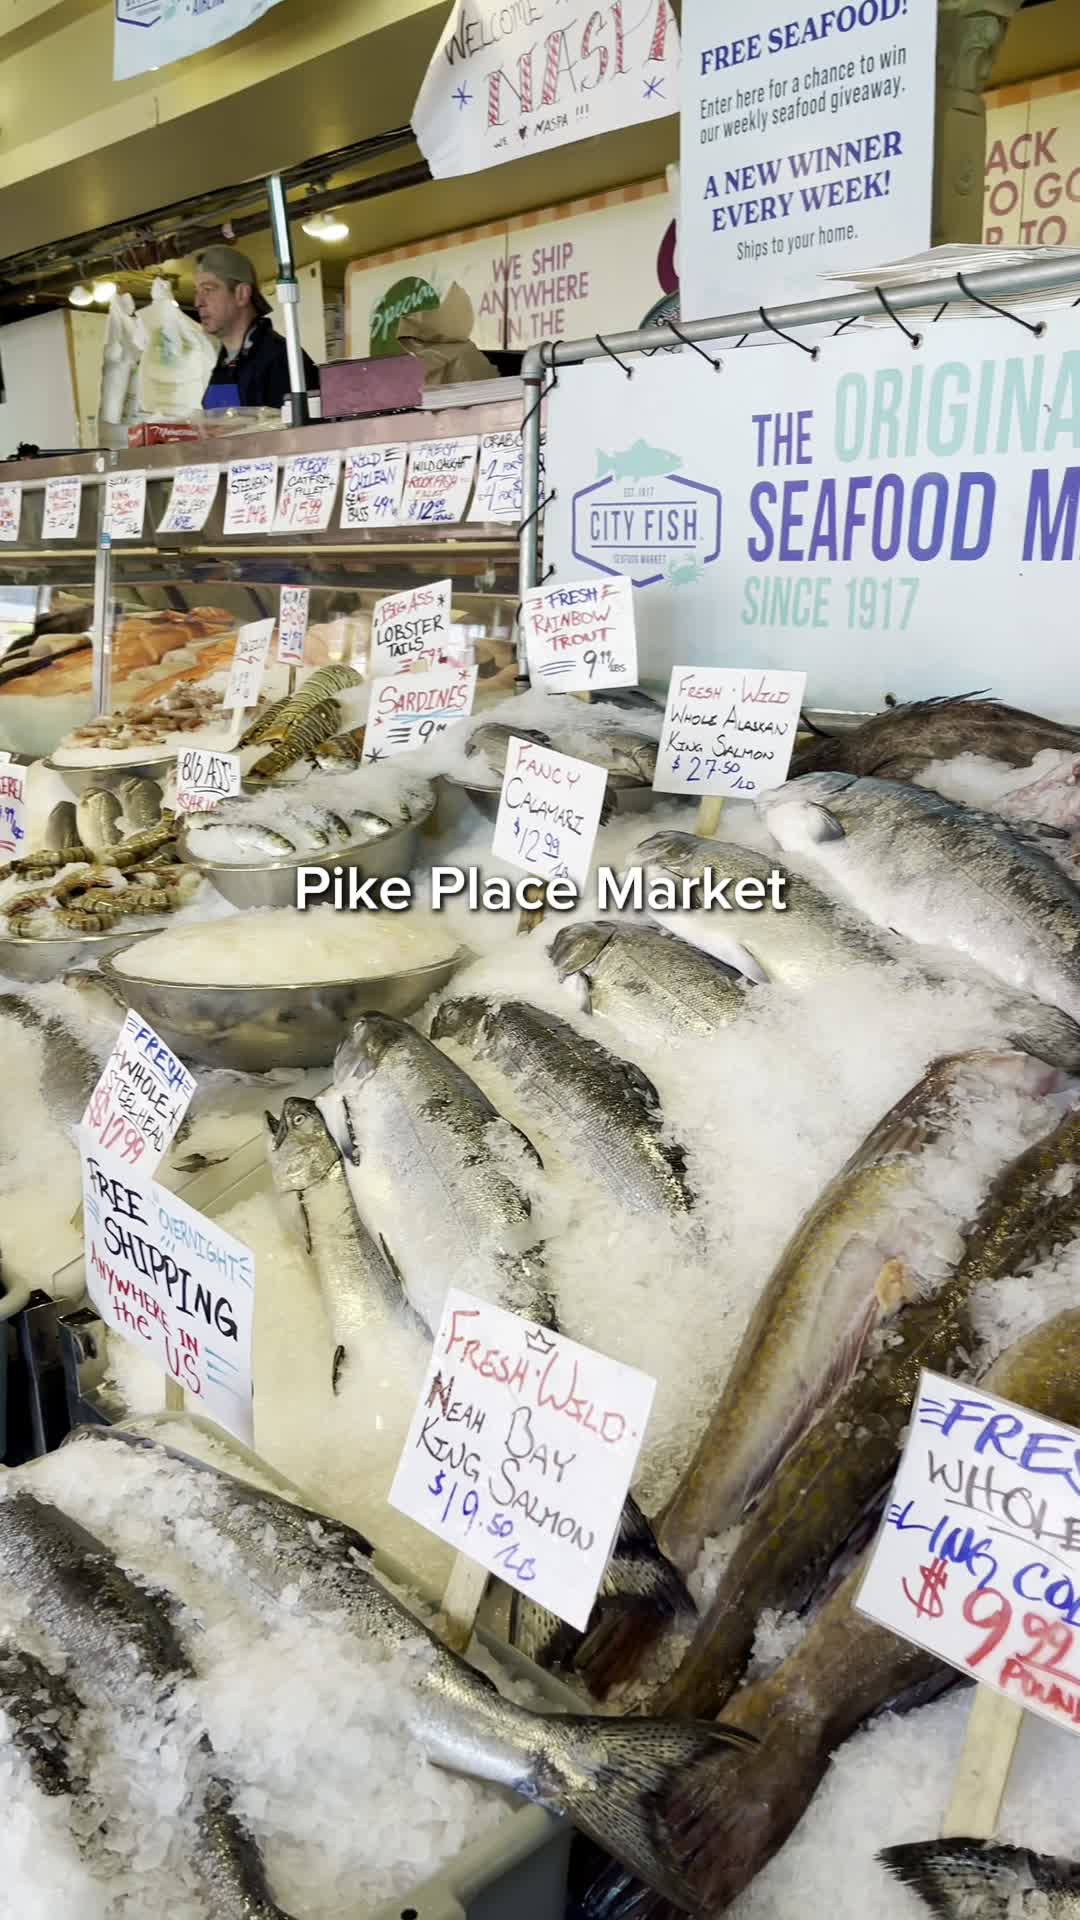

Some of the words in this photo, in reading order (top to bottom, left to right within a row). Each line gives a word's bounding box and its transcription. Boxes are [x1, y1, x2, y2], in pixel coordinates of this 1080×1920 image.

[700, 34, 762, 76] FREE
[767, 0, 908, 53] SEAFOOD!
[700, 98, 731, 120] Enter
[736, 86, 764, 109] here
[769, 79, 788, 100] for
[792, 76, 800, 93] a
[804, 61, 855, 90] chance
[861, 54, 875, 75] to
[879, 44, 906, 70] win
[534, 114, 569, 136] NASPA
[700, 127, 719, 144] our
[723, 108, 768, 137] weekly
[772, 91, 826, 125] seafood
[831, 75, 906, 113] giveaway.
[704, 175, 718, 199] A
[724, 158, 782, 194] NEW
[787, 130, 903, 179] WINNER
[712, 191, 794, 232] EVERY
[799, 169, 890, 212] WEEK!
[492, 254, 521, 283] WE
[532, 242, 573, 276] SHIP
[737, 241, 768, 261] Ships
[772, 237, 784, 252] to
[787, 232, 815, 255] your
[818, 224, 859, 245] home.
[479, 271, 589, 317] ANYWHERE
[498, 316, 522, 344] IN
[530, 308, 565, 338] THE
[752, 410, 813, 467] THE
[590, 510, 634, 541] CITY
[645, 509, 697, 541] FISH
[747, 472, 996, 562] SEAFOOD
[531, 605, 611, 636] RAINBOW
[545, 588, 598, 609] FRESH
[741, 575, 832, 628] SINCE
[845, 576, 920, 631] 1917
[377, 614, 444, 646] LOBSTER
[387, 637, 424, 658] TAILS
[545, 627, 616, 651] TROUT
[378, 684, 468, 715] SARDINES
[678, 674, 722, 700] FRESH
[741, 674, 790, 704] WILD
[670, 703, 718, 727] WHOLE
[723, 704, 789, 735] ALASKAN
[517, 744, 581, 791] FANCY
[666, 731, 703, 753] KING
[711, 734, 774, 761] SALMON
[505, 777, 584, 836] CALAMARI
[120, 1050, 169, 1119] WHOLE
[135, 1027, 187, 1092] FRESH
[87, 1157, 148, 1226] FREE
[159, 1207, 240, 1282] OVERNIGHT
[91, 1240, 172, 1336] ANYWHERE
[178, 1328, 198, 1356] IN
[104, 1217, 238, 1342] SHIPPING
[113, 1296, 152, 1340] the
[425, 1370, 485, 1433] NEAH
[504, 1406, 576, 1483] BAY
[416, 1416, 480, 1484] KING
[488, 1458, 595, 1550] SALMON
[896, 1500, 997, 1590] LING
